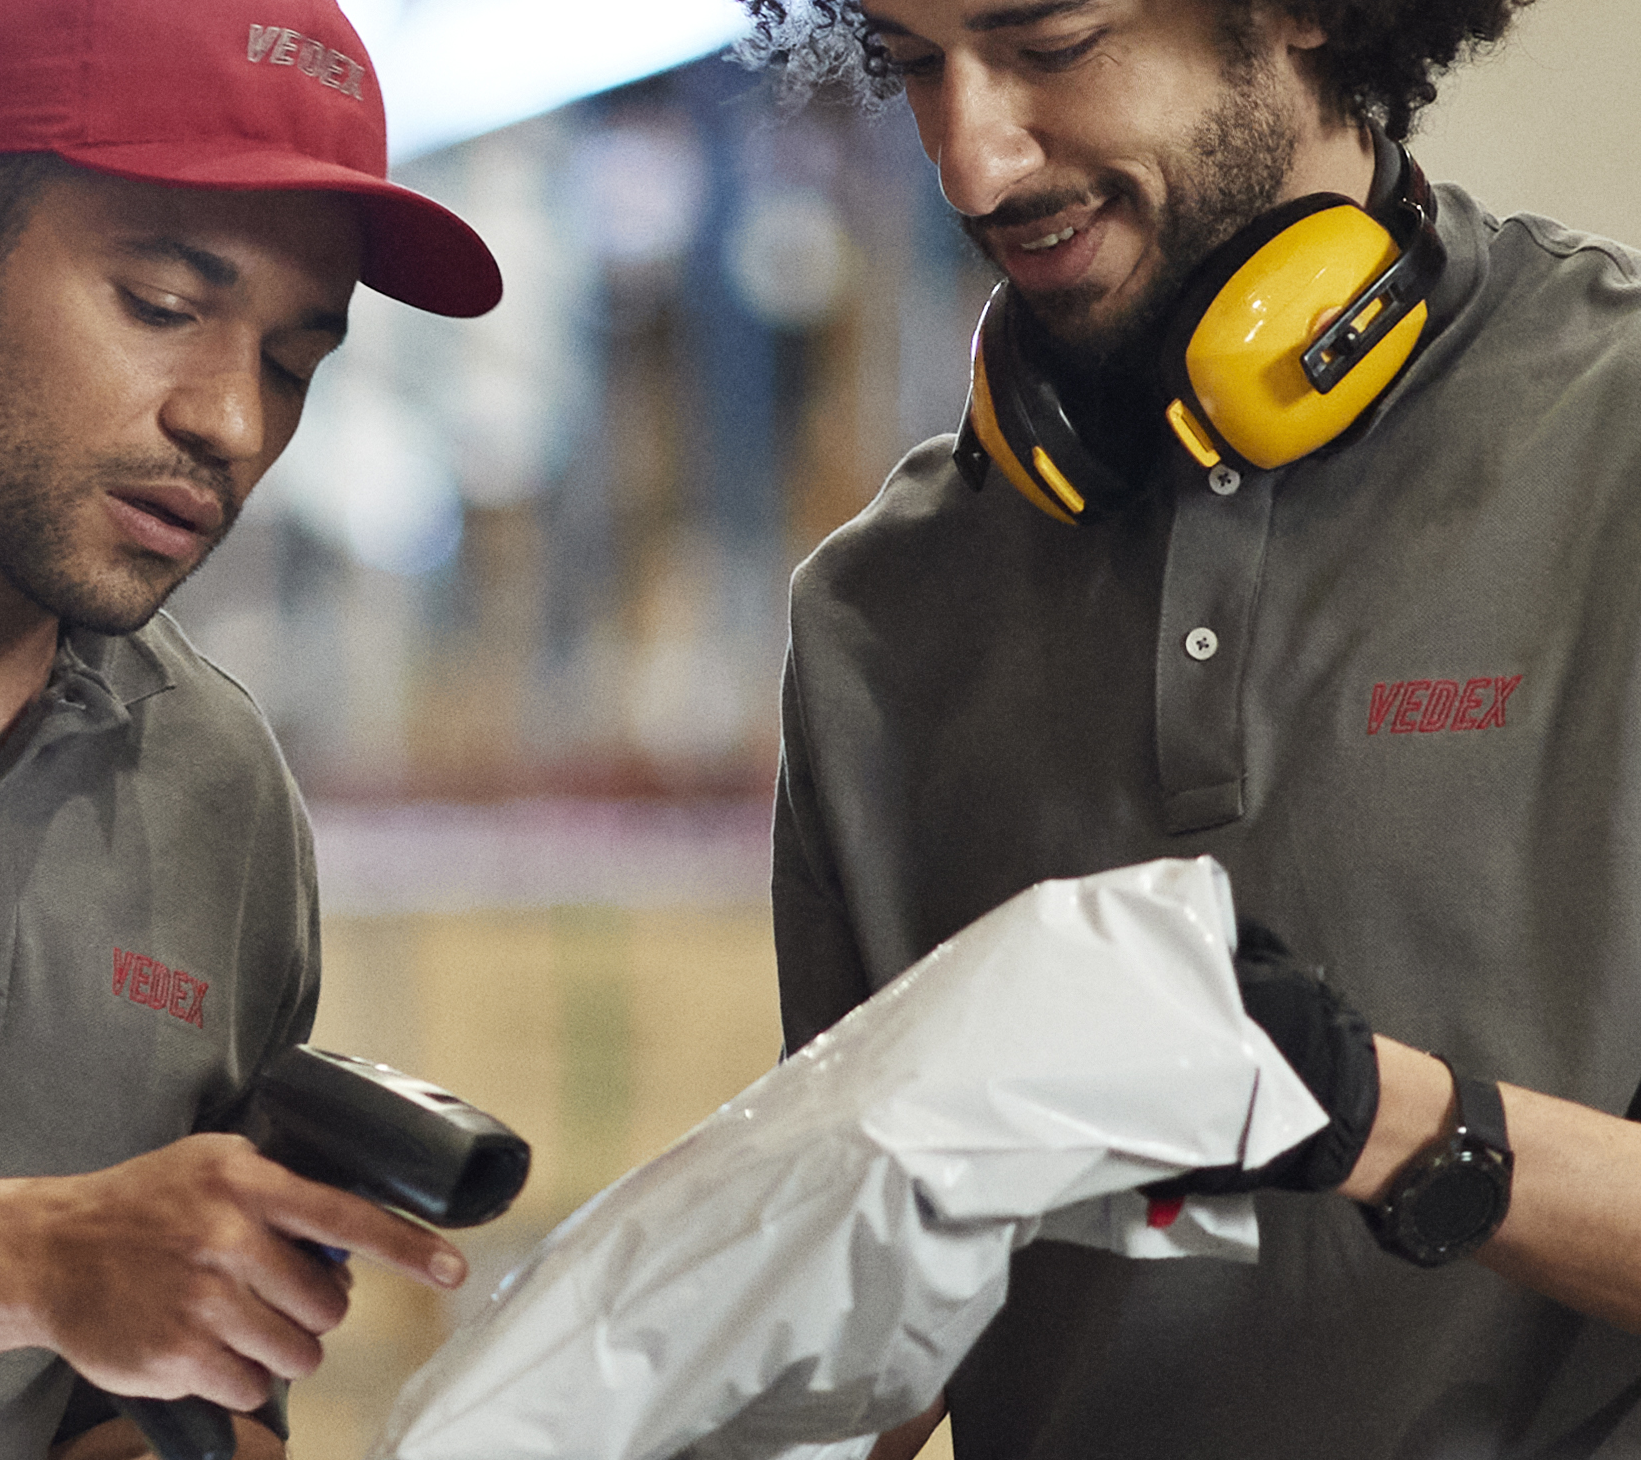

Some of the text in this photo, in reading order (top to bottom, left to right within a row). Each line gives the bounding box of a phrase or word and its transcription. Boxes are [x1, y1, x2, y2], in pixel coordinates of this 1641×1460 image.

[247, 23, 365, 101] VEDEX
[1367, 673, 1523, 735] VEDEX
[112, 946, 209, 1030] VEDEX
